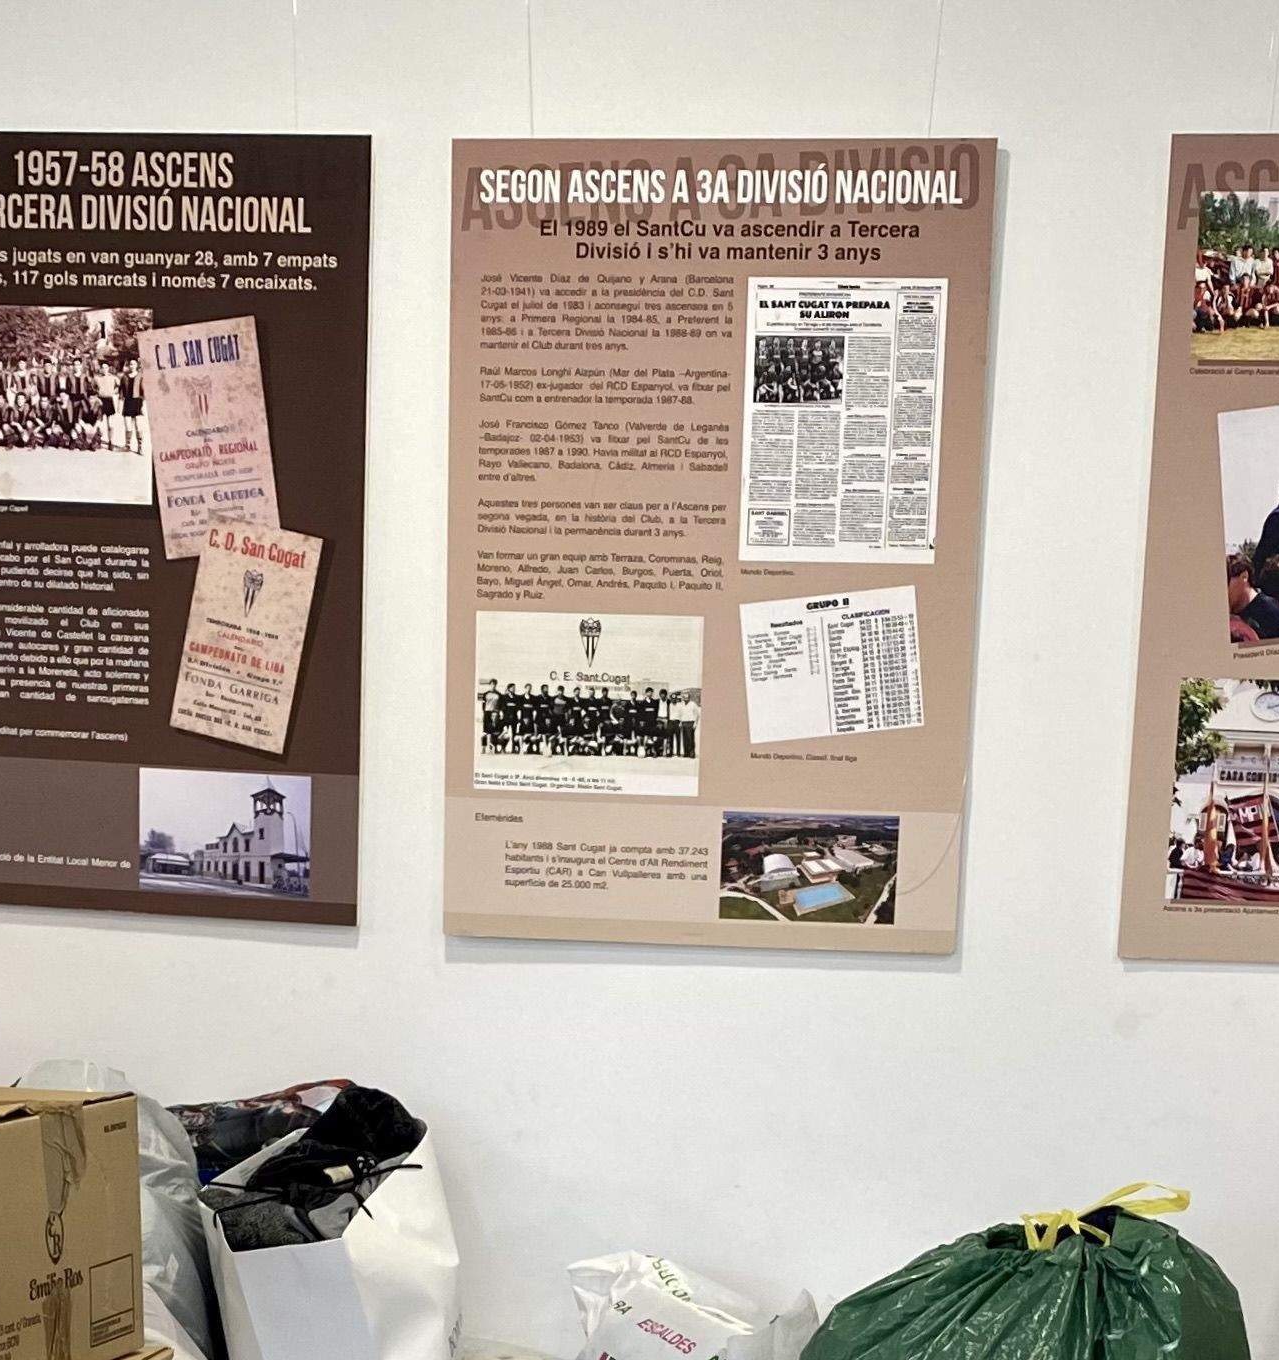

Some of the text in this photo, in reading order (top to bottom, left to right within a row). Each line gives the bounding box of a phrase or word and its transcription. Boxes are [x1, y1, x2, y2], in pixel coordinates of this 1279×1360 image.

[14, 151, 233, 188] 1957-58 ASCENS
[479, 164, 962, 204] SEGON ASCENS A 3A DIVISIÓ NACIONAL
[81, 189, 173, 232] DIVISIÓ
[181, 197, 311, 234] NACIONAL
[540, 219, 919, 238] El 1989 el SantCu va ascendir a Tercera
[12, 247, 61, 266] jugats
[66, 252, 86, 264] en
[91, 252, 119, 264] van
[125, 253, 189, 268] guanyar
[196, 251, 219, 267] 28,
[223, 252, 258, 267] amb
[263, 253, 272, 267] 7
[278, 254, 337, 271] empats
[760, 301, 890, 310] EL SANT CUGAT YA PREPARA
[800, 310, 849, 319] SU ALIRON
[209, 529, 306, 568] C. D. San Cugat
[637, 1317, 697, 1355] ESCALDES
